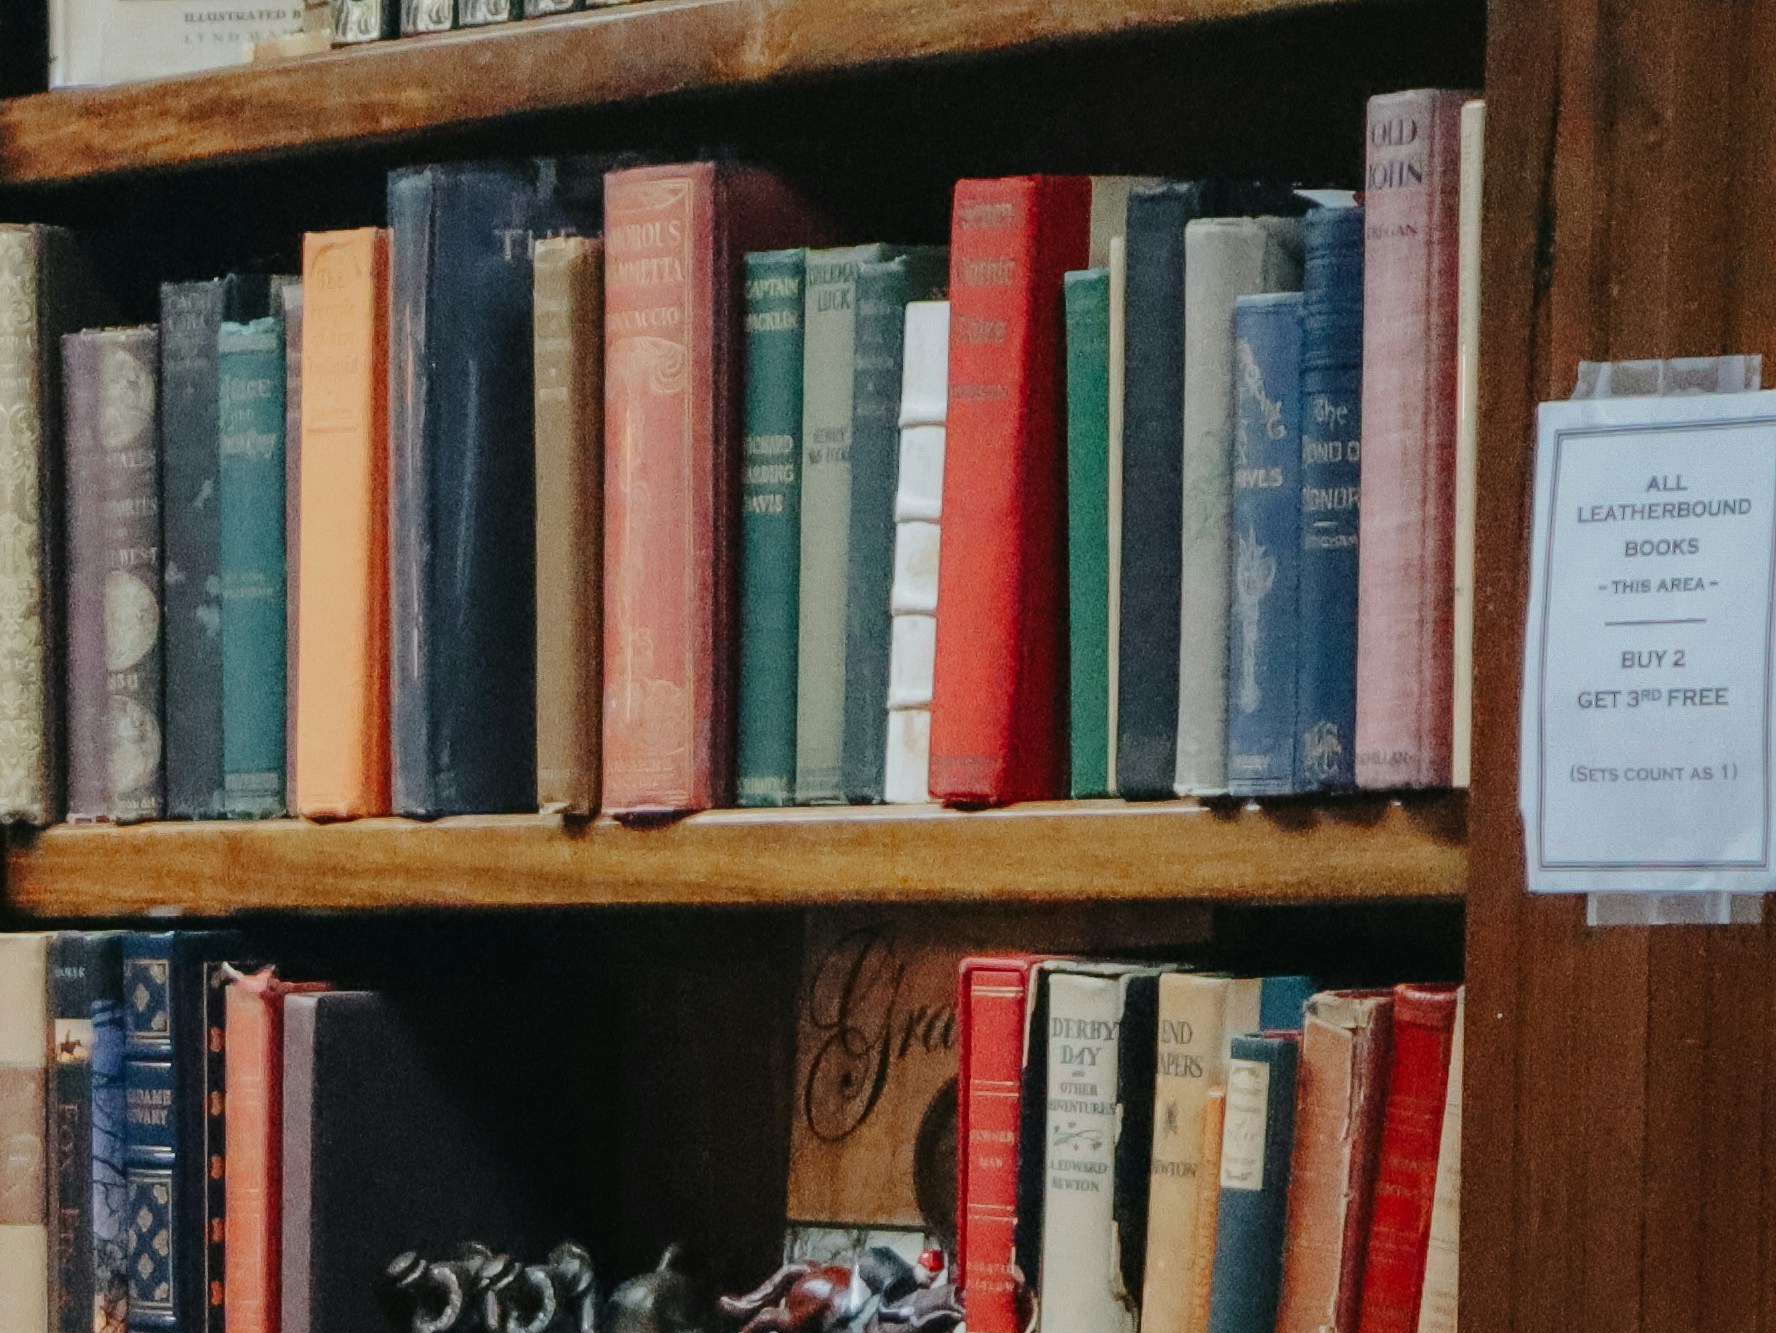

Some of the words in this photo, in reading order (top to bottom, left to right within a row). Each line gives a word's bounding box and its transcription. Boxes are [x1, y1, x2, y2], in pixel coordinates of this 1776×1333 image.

[183, 10, 287, 24] ILLUSTRATED
[1371, 118, 1419, 148] OLD
[1368, 163, 1424, 191] JOHN
[1646, 474, 1688, 493] ALL
[1576, 498, 1753, 524] LEATHERBOUND
[1623, 538, 1700, 558] BOOKS
[1619, 650, 1668, 670] BUY
[1672, 648, 1687, 668] 2
[1576, 688, 1624, 710] GET
[1666, 686, 1730, 708] FREE
[1051, 1017, 1120, 1041] DERBY
[1060, 1046, 1103, 1066] DAY
[1159, 1053, 1204, 1079] APERS
